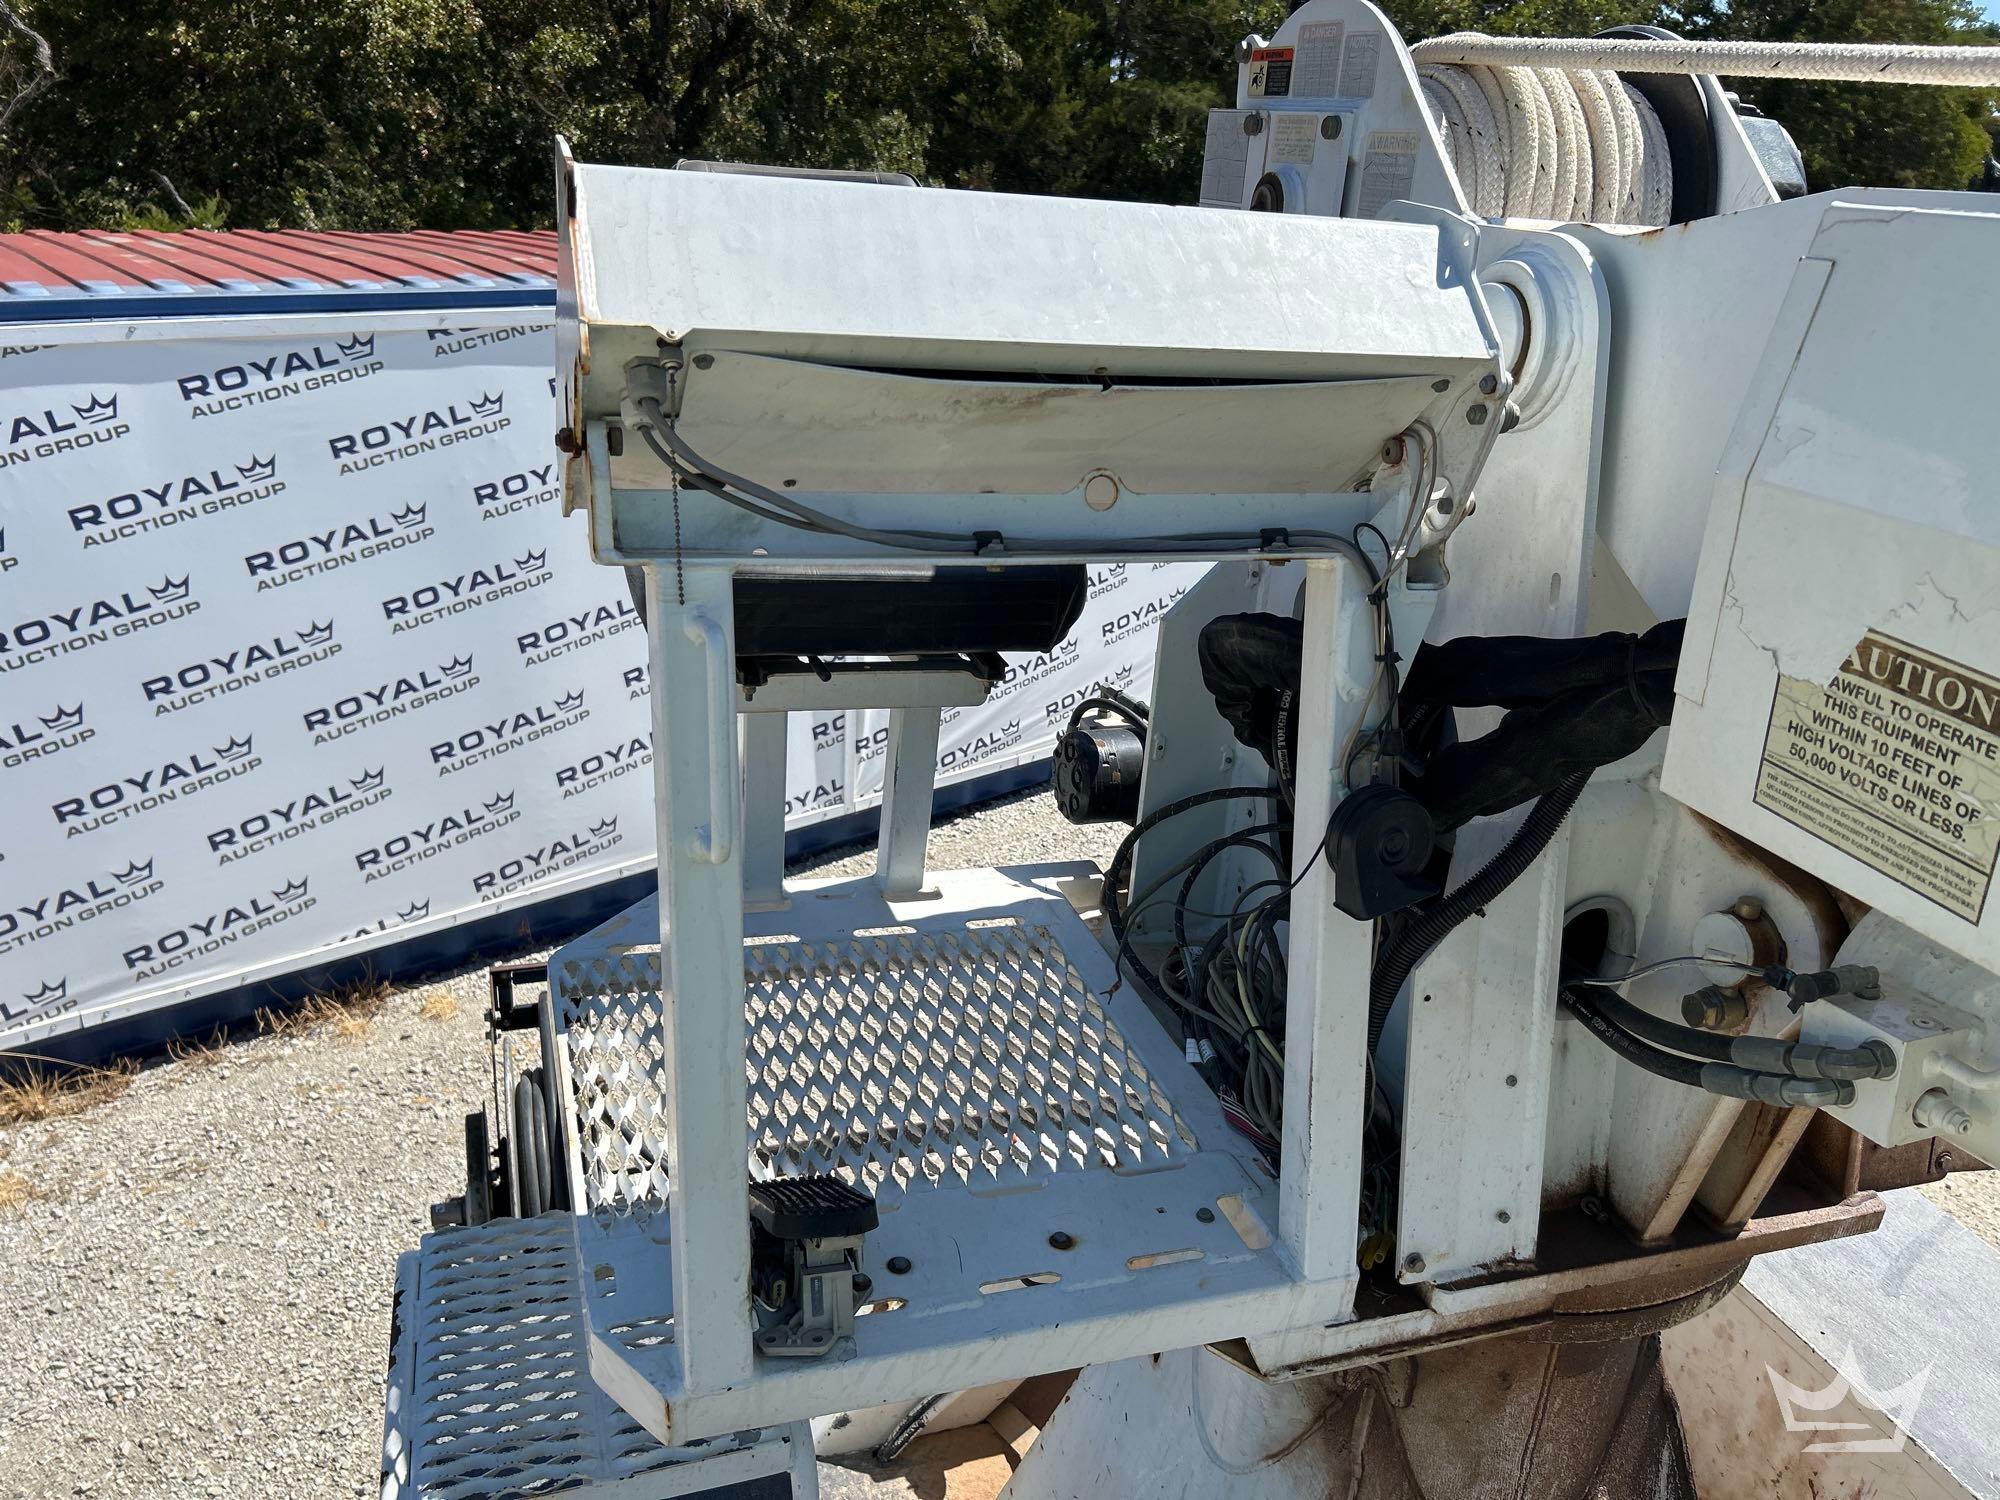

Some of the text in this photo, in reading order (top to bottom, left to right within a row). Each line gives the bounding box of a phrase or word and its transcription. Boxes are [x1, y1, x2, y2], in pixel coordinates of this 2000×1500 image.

[1375, 135, 1417, 152] WARNING
[435, 325, 526, 358] AUCTION
[177, 346, 341, 401] ROYAL
[192, 361, 384, 420] AUCTION GROUP
[35, 424, 130, 458] GROUP
[328, 405, 472, 460] ROYAL
[339, 417, 511, 476] AUCTION GROUP
[67, 470, 240, 532] ROYAL
[83, 481, 286, 549] AUCTION GROUP
[473, 464, 559, 506] ROY
[244, 517, 394, 577] ROYAL
[257, 527, 435, 593] AUCTION GROUP
[381, 563, 517, 621] ROYAL
[392, 571, 553, 635] AUCTION GROUP
[1090, 577, 1128, 600] GROUP
[1102, 597, 1169, 638] ROYAL
[112, 601, 201, 637] GROUP
[517, 600, 635, 654] ROYAL
[525, 616, 644, 668] AUCTION GRO
[1104, 619, 1150, 648] AUCTION
[141, 637, 300, 702] ROYAL
[155, 643, 343, 717] AUCTION GROUP
[1041, 654, 1080, 678] GROUP
[303, 671, 442, 732] ROYAL
[314, 676, 480, 746] AUCTION GROUP
[1277, 711, 1288, 747] TOUGH
[1823, 693, 1960, 766] THIS EQUIPMENT
[1828, 676, 1999, 760] AWFUL TO OPERATE
[3, 728, 96, 768] GROUP
[430, 706, 557, 764] ROYAL
[439, 709, 590, 778] AUCTION GROUP
[555, 733, 653, 788] ROYA
[936, 732, 1001, 771] OYAL
[981, 735, 1022, 759] GROUP
[1812, 710, 1963, 790] WITHIN 10 FEET OF
[51, 754, 218, 824] ROYAL
[67, 757, 263, 839] AUCTION GROUP
[563, 759, 638, 800] AUCTION
[1787, 720, 1825, 748] HIGH
[1829, 739, 1900, 785] VOLTAGE
[1902, 775, 1952, 810] LINES
[1955, 802, 1981, 821] OF
[1789, 742, 1836, 775] 50,000
[1840, 766, 1889, 801] VOLTS
[1892, 794, 1916, 816] OR
[1920, 806, 1966, 843] LESS.
[207, 785, 353, 853] ROYAL
[219, 788, 392, 867] AUCTION GROUP
[355, 808, 485, 872] ROYAL
[365, 810, 521, 884] AUCTION GROUP
[1886, 834, 1896, 846] TO
[472, 833, 591, 894] ROYAL
[480, 834, 623, 903] AUCTION GROUP
[0, 880, 164, 955] CTION GROUP
[122, 897, 276, 970] ROYAL
[135, 931, 238, 982] AUCTION
[241, 897, 317, 937] GROUP
